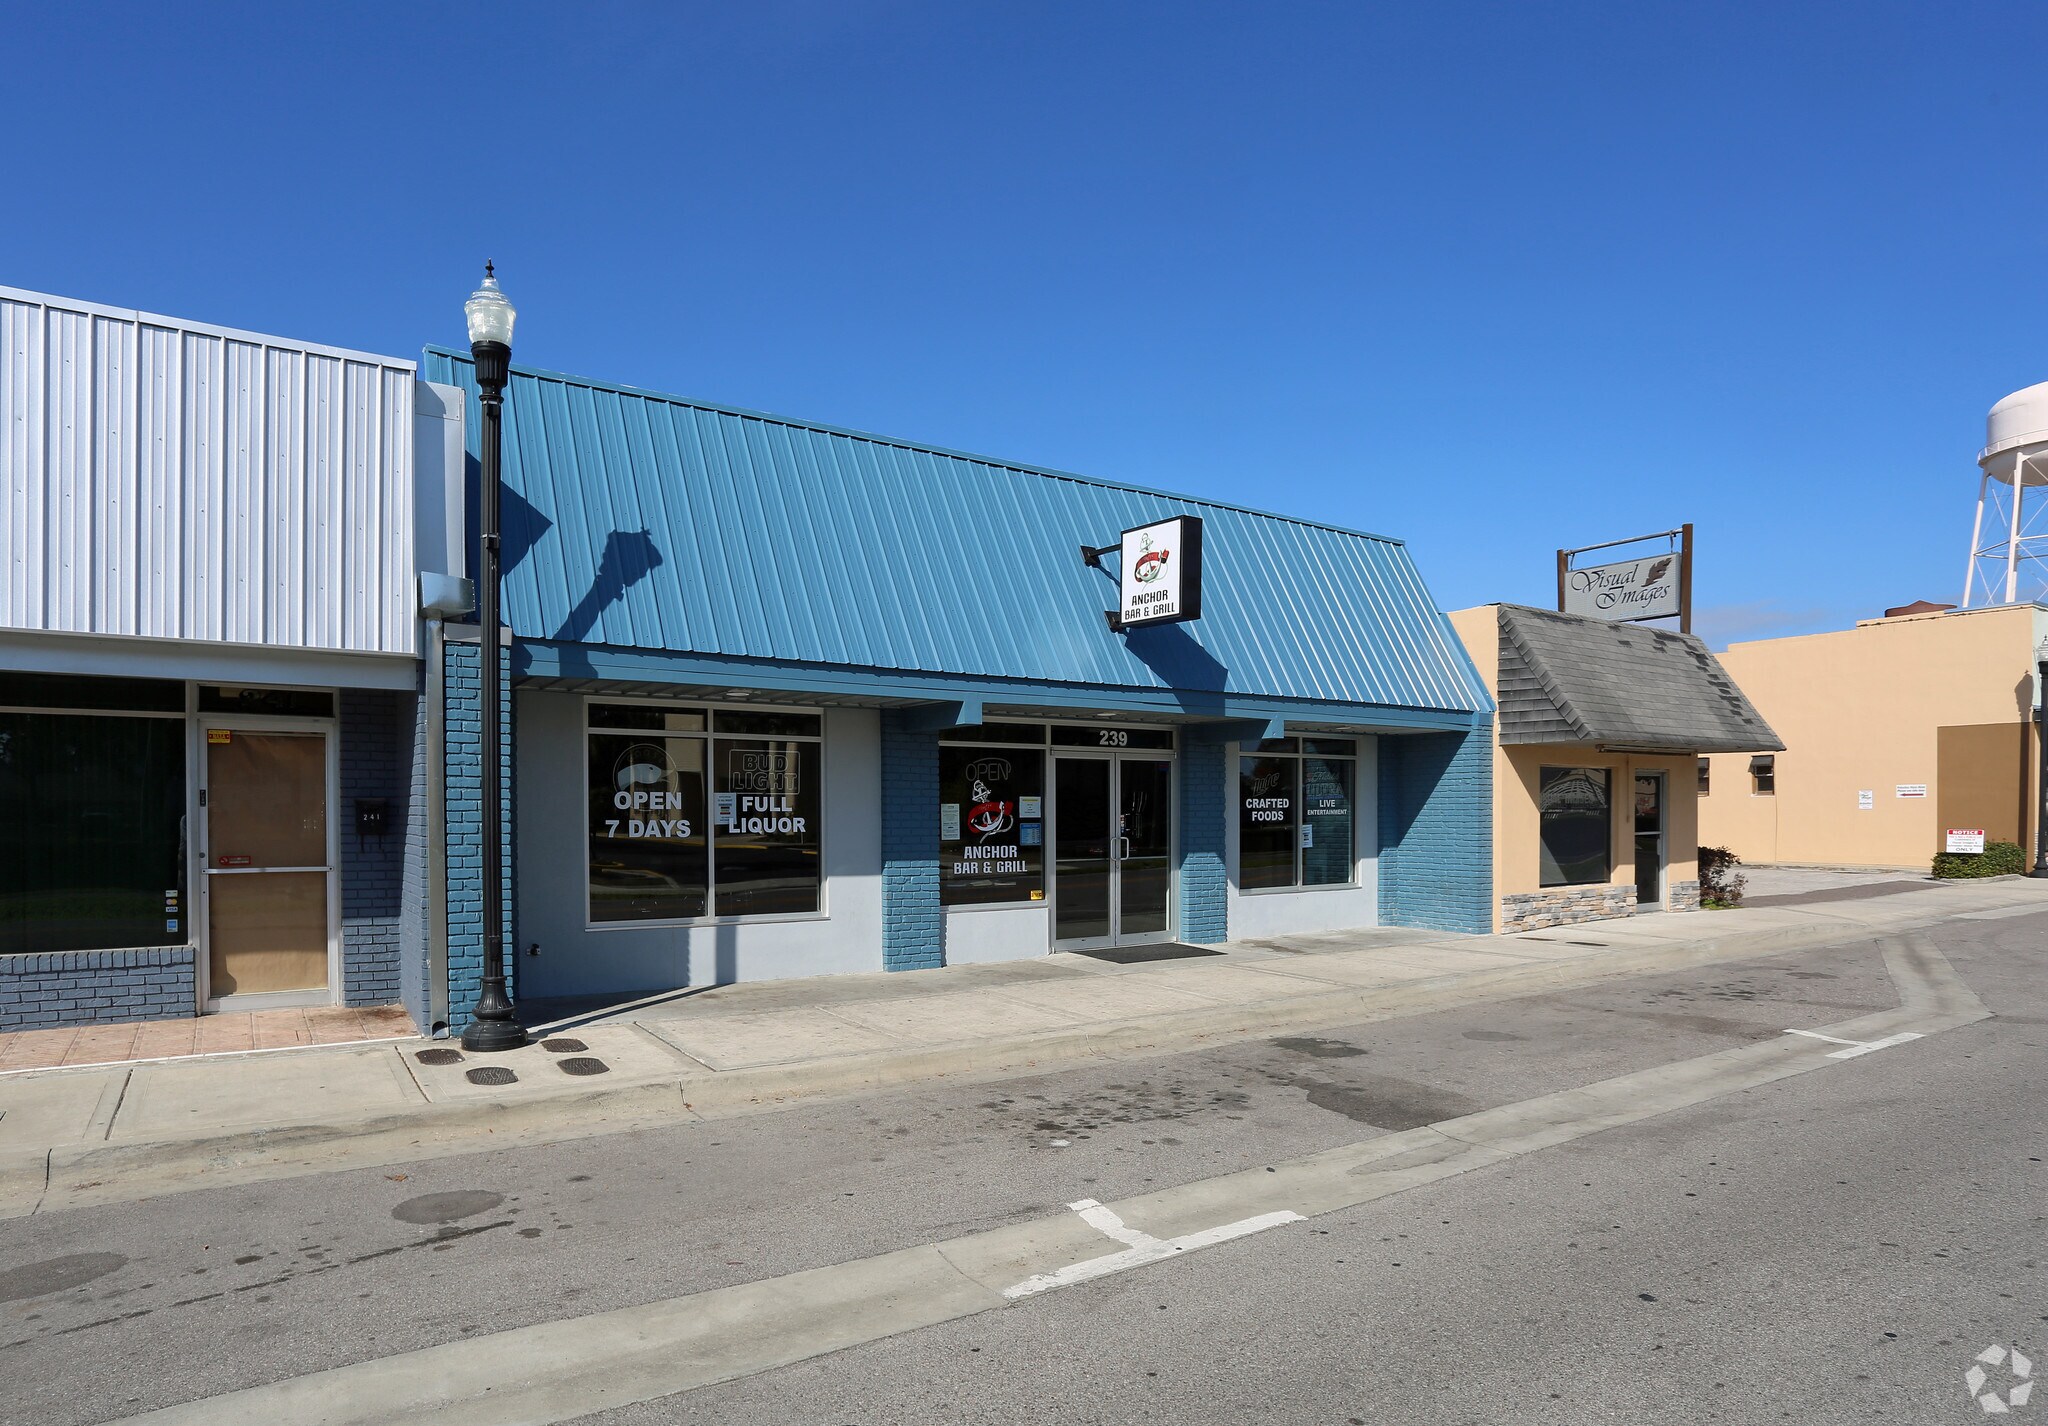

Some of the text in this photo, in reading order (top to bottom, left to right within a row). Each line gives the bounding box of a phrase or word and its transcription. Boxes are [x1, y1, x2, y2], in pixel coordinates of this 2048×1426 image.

[1571, 564, 1639, 593] Visual
[1131, 590, 1168, 606] ANCHOR
[1595, 584, 1670, 609] Images
[1125, 602, 1175, 620] BAR & GRILL
[1099, 730, 1128, 746] 239
[742, 753, 788, 772] BUD
[733, 772, 797, 790] LIGHT
[965, 763, 1009, 782] OPEN
[614, 791, 682, 810] OPEN
[742, 796, 792, 812] FULL
[1245, 798, 1290, 809] CRAFTED
[1319, 799, 1335, 808] LIVE
[363, 813, 380, 821] 241
[1251, 811, 1284, 821] FOODS
[605, 819, 691, 838] 7 DAYS
[728, 817, 806, 835] LIQUOR
[963, 845, 1018, 860] ANCHOR
[953, 860, 1028, 875] BAR & GRILL
